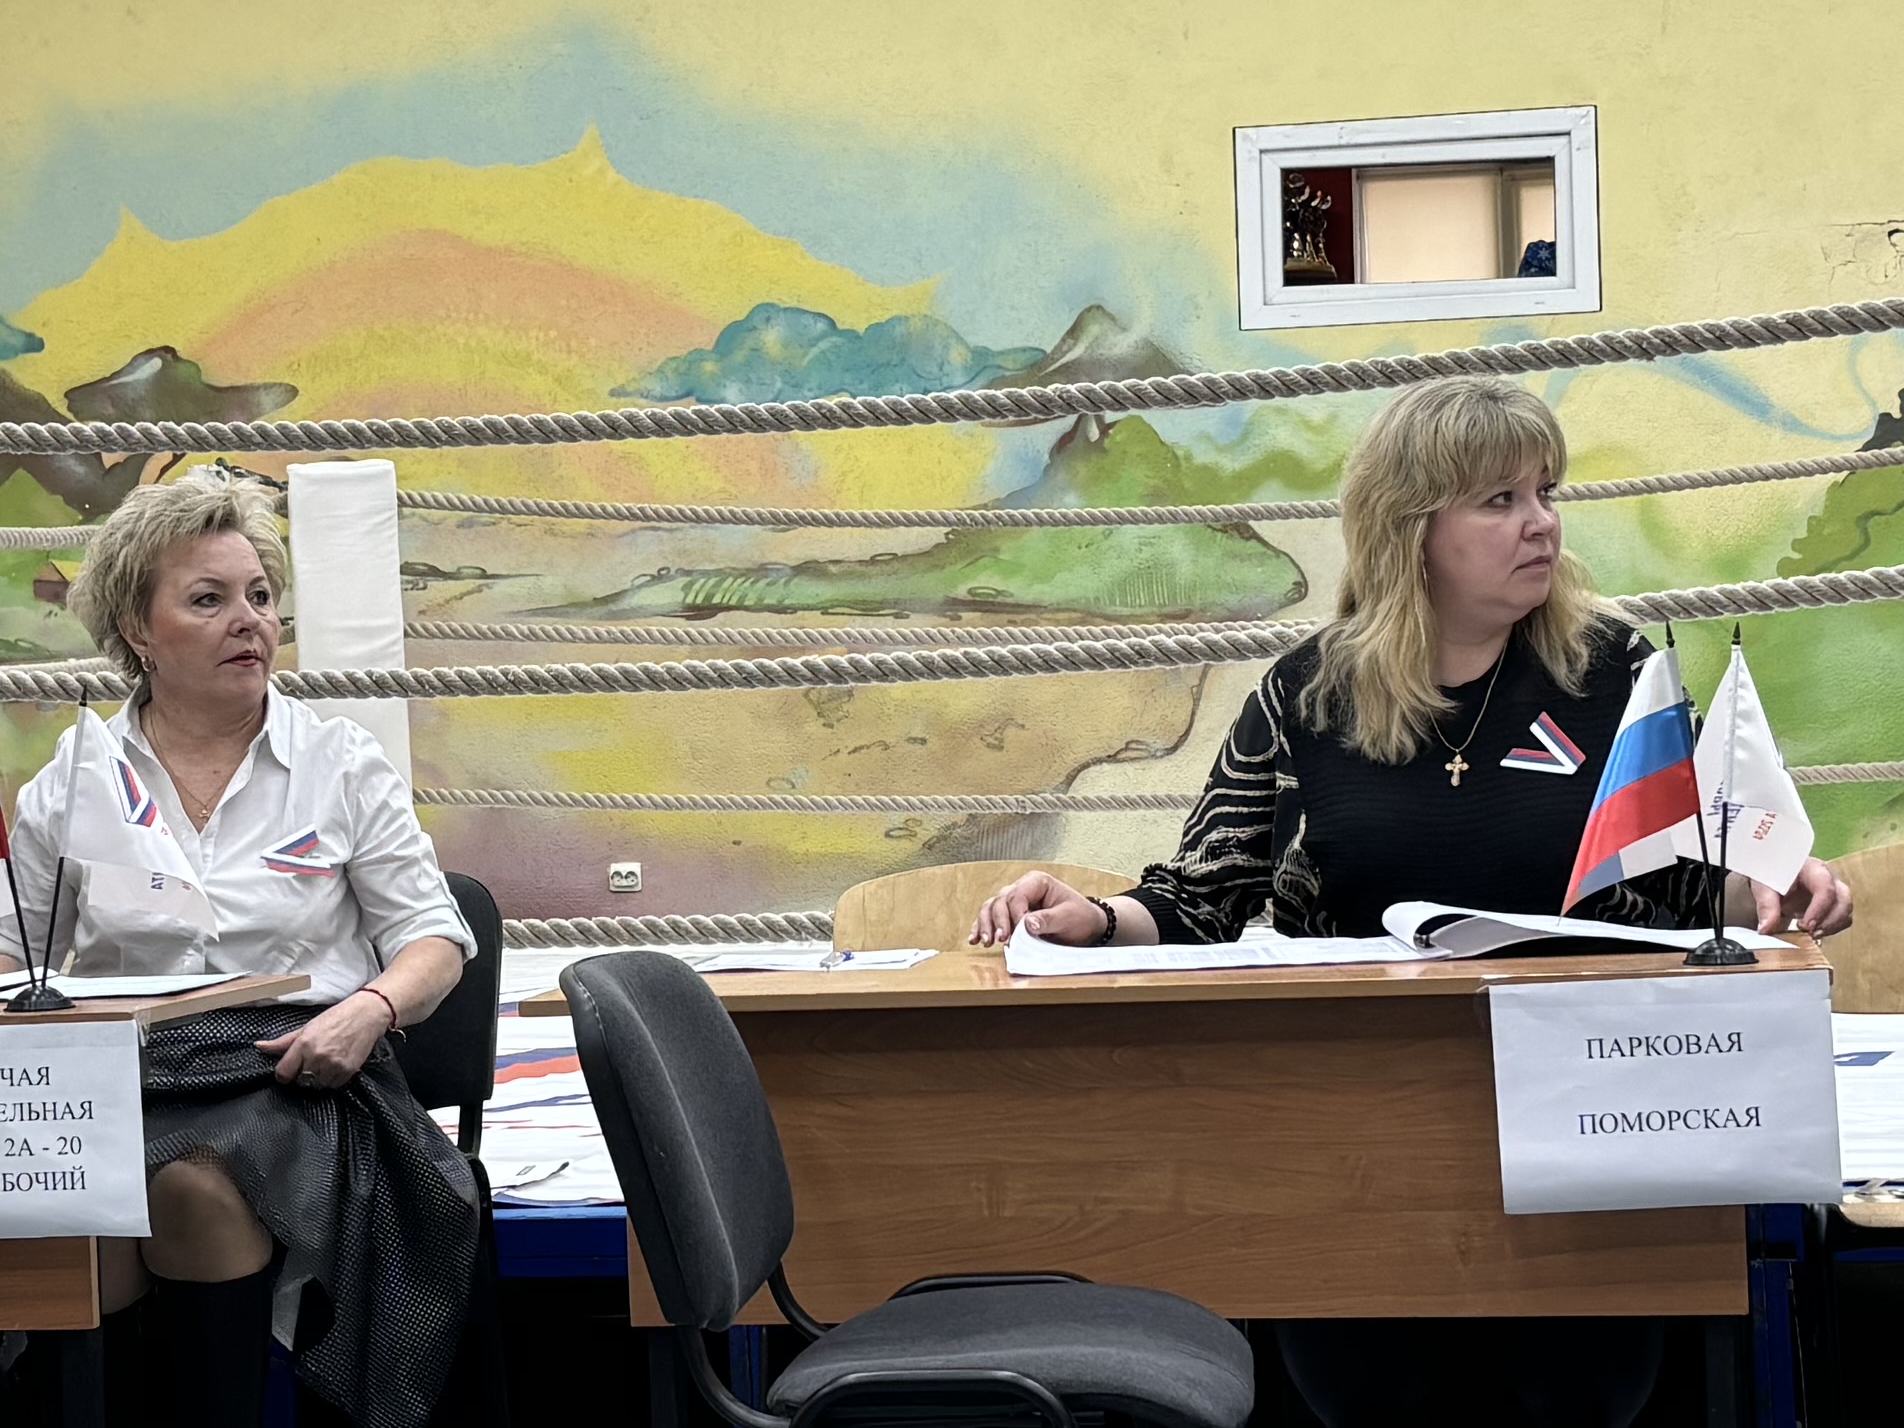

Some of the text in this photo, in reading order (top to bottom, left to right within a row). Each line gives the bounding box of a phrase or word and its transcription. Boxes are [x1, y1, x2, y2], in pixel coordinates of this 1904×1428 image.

[1586, 1031, 1744, 1060] ПАРКОВАЯ
[1578, 1106, 1762, 1135] ПОМОРСКАЯ
[4, 1137, 35, 1157] 2А
[56, 1135, 82, 1156] 20
